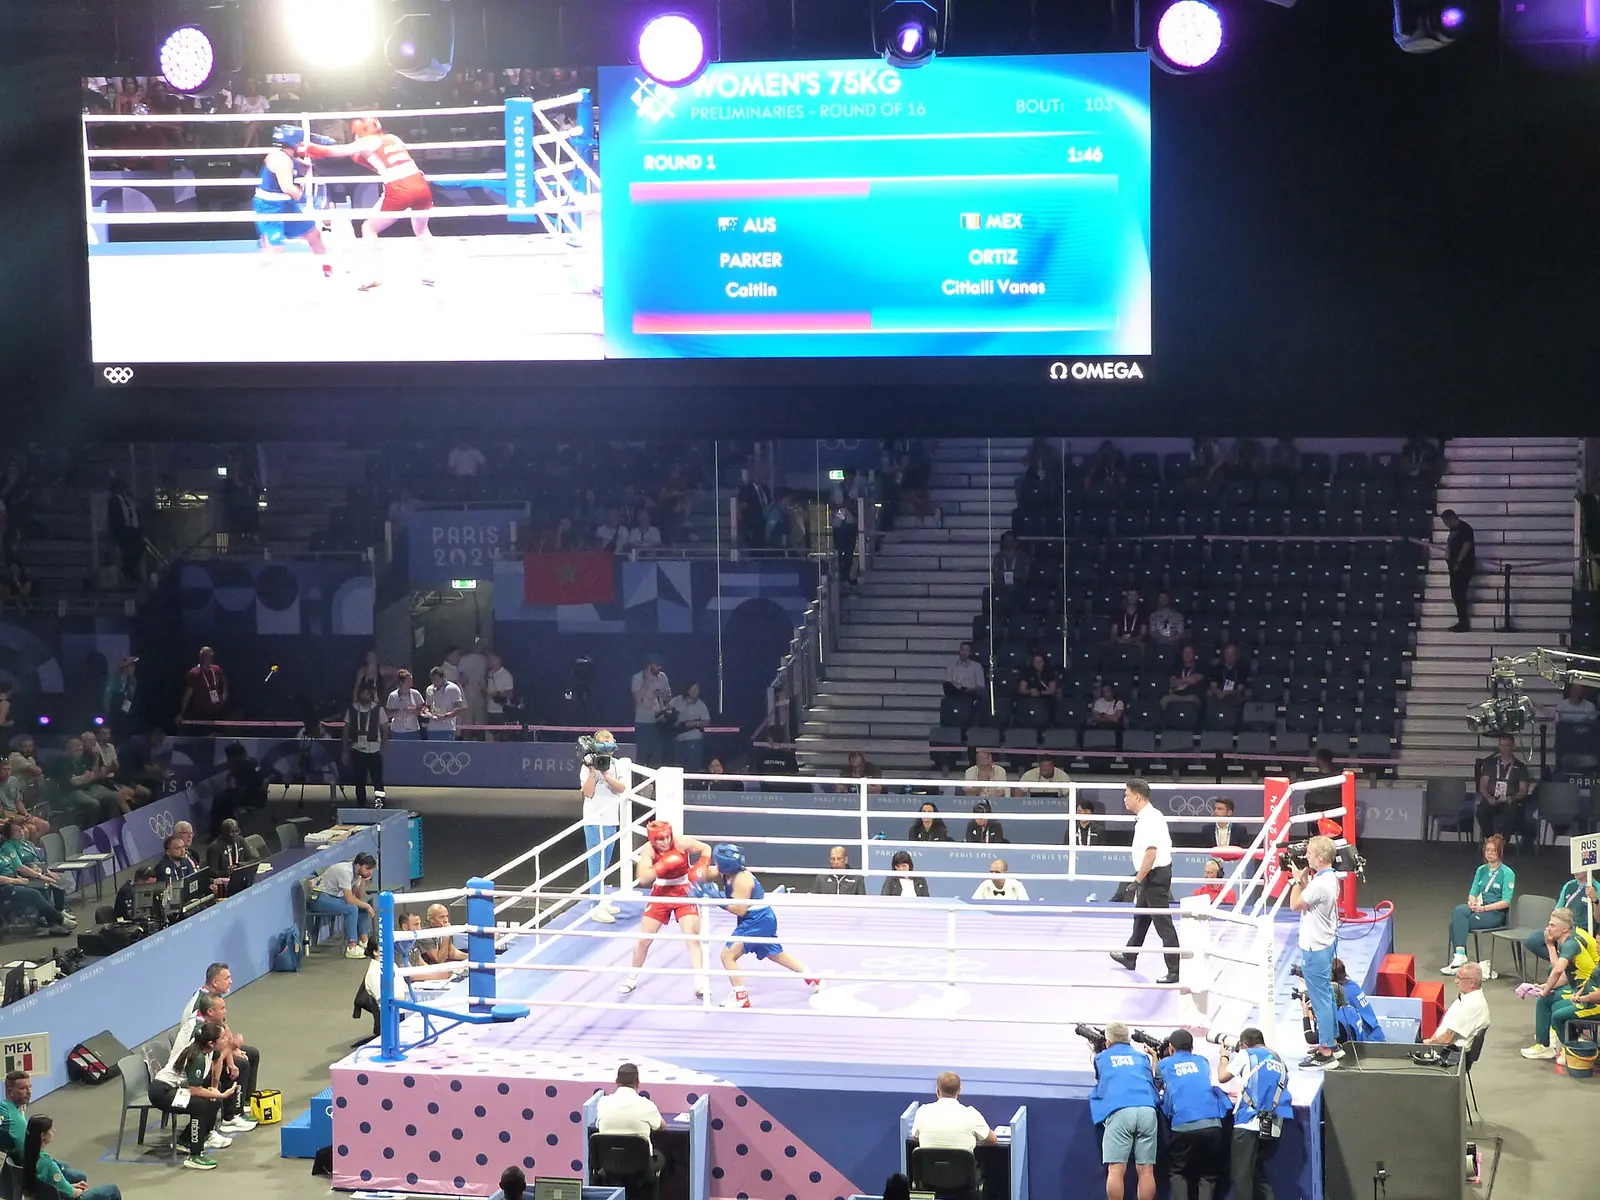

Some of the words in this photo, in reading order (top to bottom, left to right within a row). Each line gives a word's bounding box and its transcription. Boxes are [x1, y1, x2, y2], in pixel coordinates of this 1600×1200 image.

[693, 71, 821, 98] WOMEN'S
[828, 69, 902, 95] 75KG
[690, 105, 804, 121] PRELIMINARIES
[820, 103, 877, 118] ROUND
[881, 102, 903, 117] OF
[907, 100, 926, 116] 16
[1015, 98, 1065, 114] BOUT:
[1084, 97, 1114, 112] 103
[643, 155, 703, 171] ROUND
[706, 155, 716, 170] 1
[1067, 147, 1104, 163] 1:46
[743, 217, 777, 233] AUS
[986, 213, 1023, 229] MEX
[720, 252, 783, 268] PARKER
[968, 249, 1018, 265] ORTIZ
[725, 281, 777, 298] Caitlin
[997, 279, 1046, 294] Vanes
[1071, 362, 1144, 379] OMEGA
[522, 758, 575, 772] PARIS
[1580, 839, 1597, 850] AUS
[4, 1041, 32, 1055] MEX
